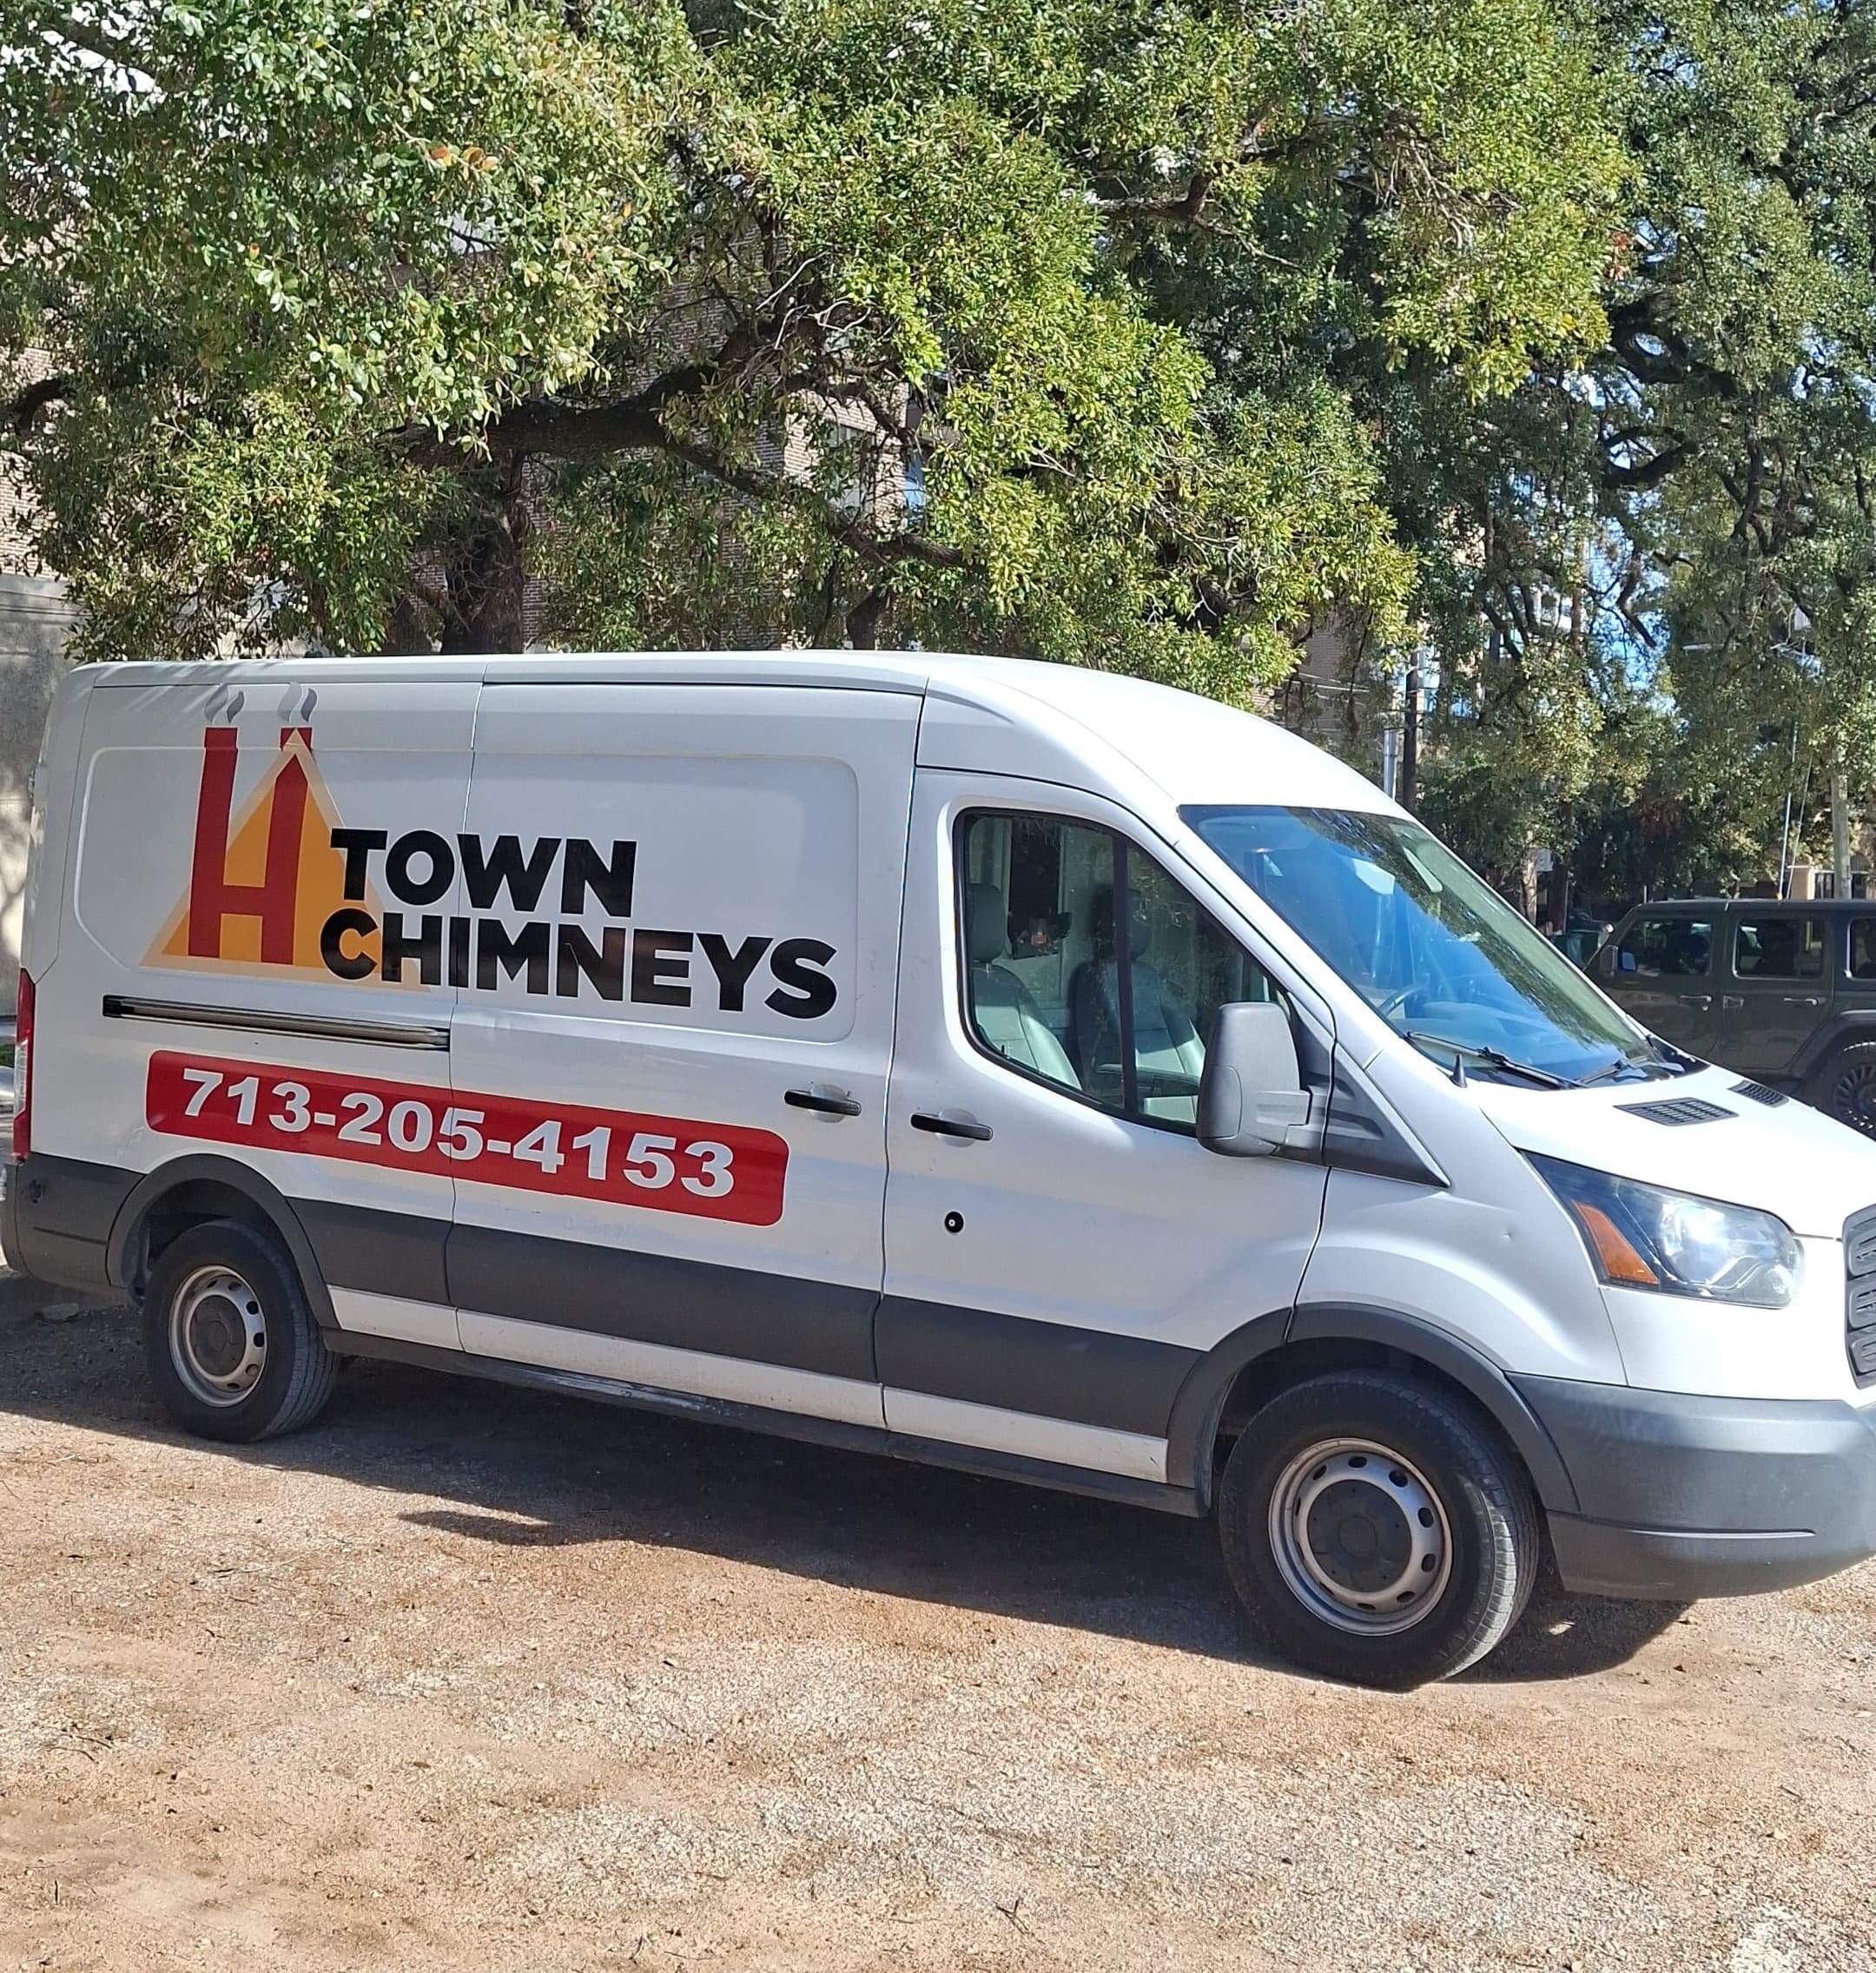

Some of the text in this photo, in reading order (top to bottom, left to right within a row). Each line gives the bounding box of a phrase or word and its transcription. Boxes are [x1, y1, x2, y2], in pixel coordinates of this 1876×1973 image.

[188, 727, 637, 965] H TOWN
[320, 908, 837, 1019] CHIMNEYS
[183, 1069, 736, 1198] 713-205-4153
